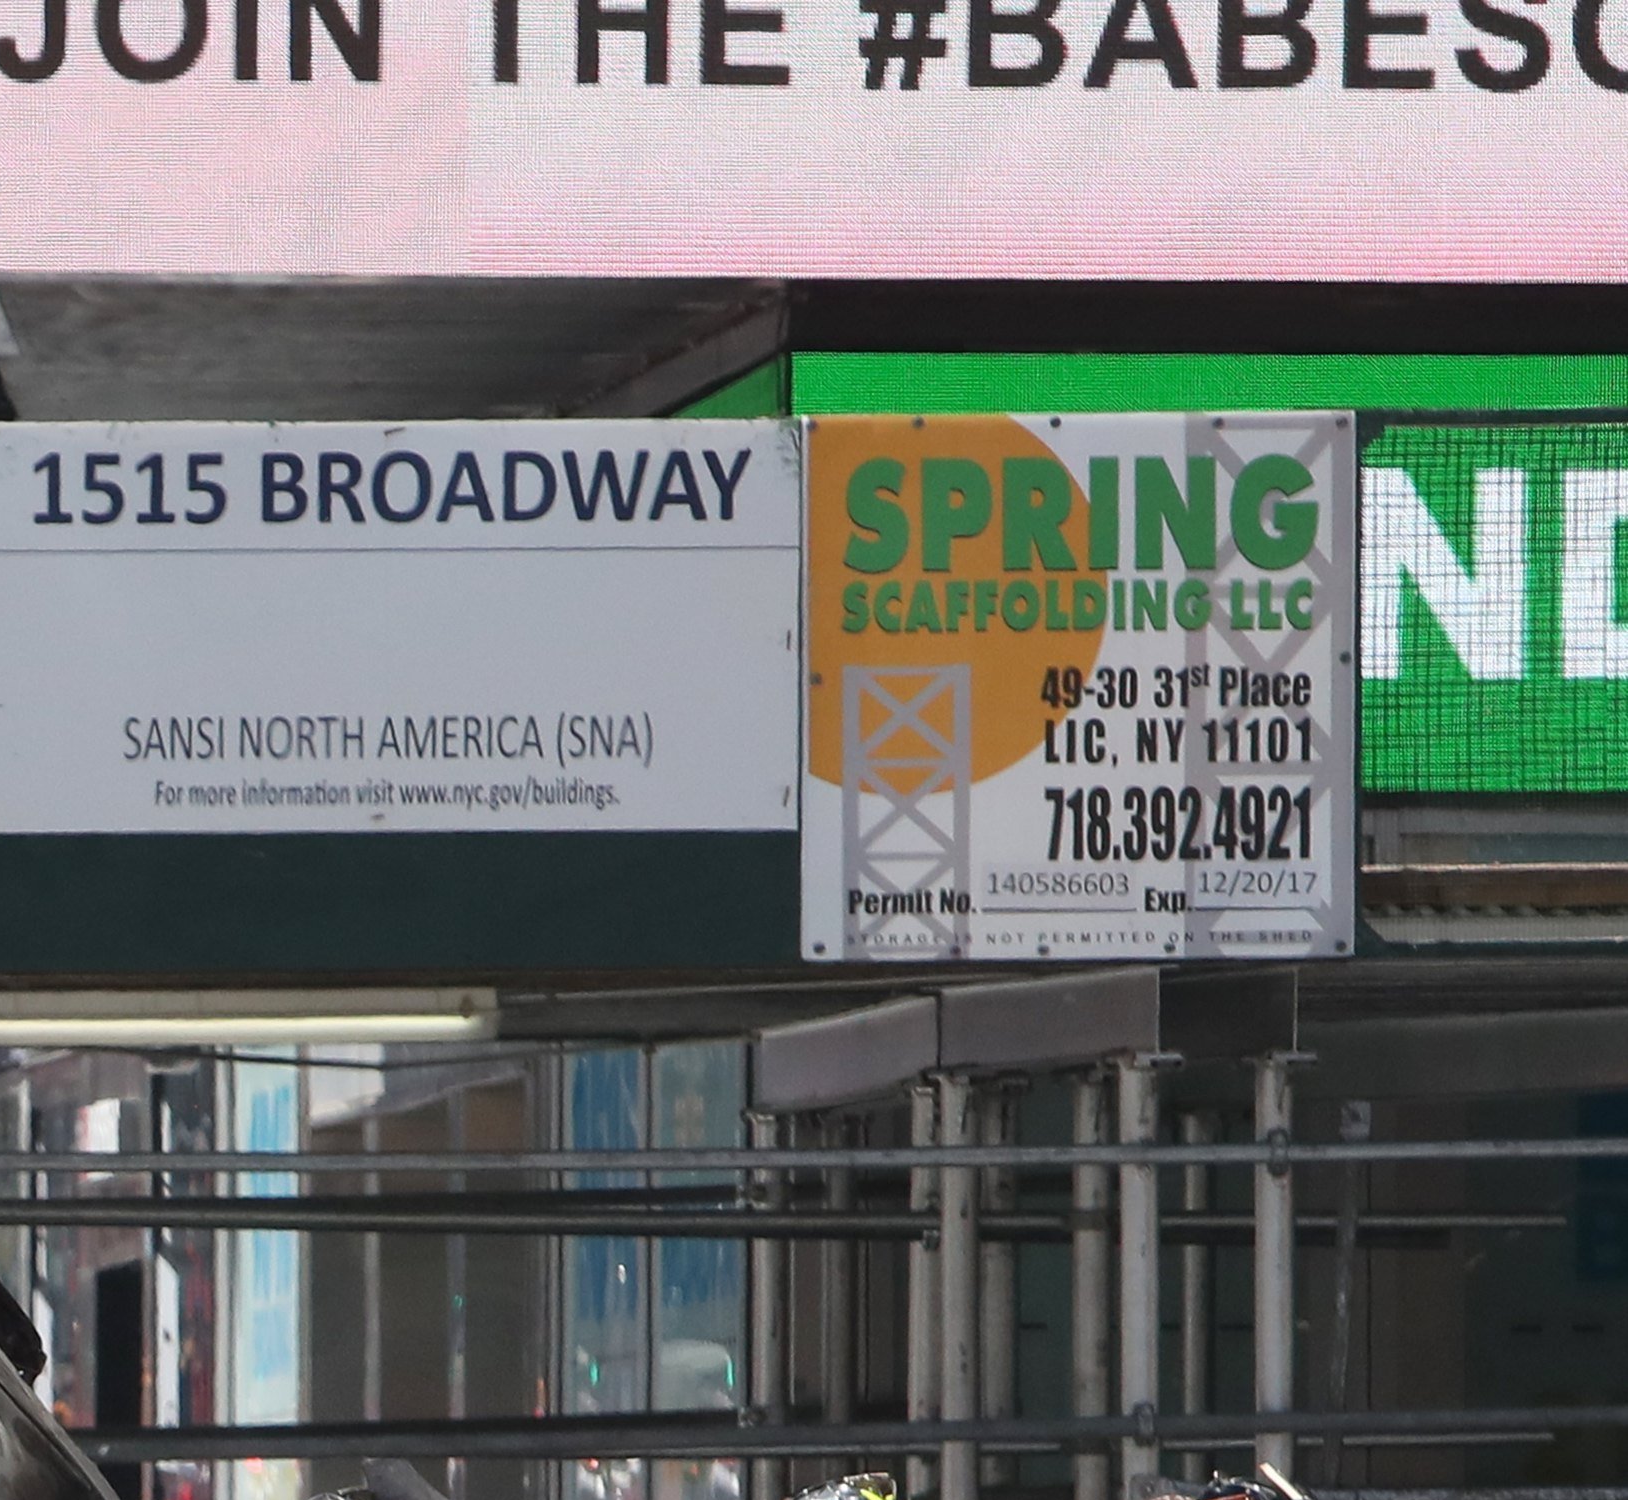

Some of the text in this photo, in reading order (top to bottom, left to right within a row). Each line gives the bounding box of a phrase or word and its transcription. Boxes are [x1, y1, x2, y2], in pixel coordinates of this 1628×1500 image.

[494, 0, 790, 85] THE
[31, 449, 753, 526] 1515 BROADWAY
[844, 454, 1320, 574] SPRING
[841, 579, 1314, 635] SCAFFOLDING LLC
[1041, 661, 1312, 709] 49-30 31st Place
[123, 711, 654, 769] SANSI NORTH AMERICA (SNA)
[1044, 717, 1312, 769] LIC, NY 11101
[154, 780, 185, 805] For
[188, 784, 236, 806] more
[241, 778, 350, 806] information
[356, 780, 395, 805] visit
[1044, 786, 1313, 862] 718.392.4921
[847, 888, 1194, 916] Permit No. Exp.
[987, 870, 1318, 898] 140586603 12/20/17
